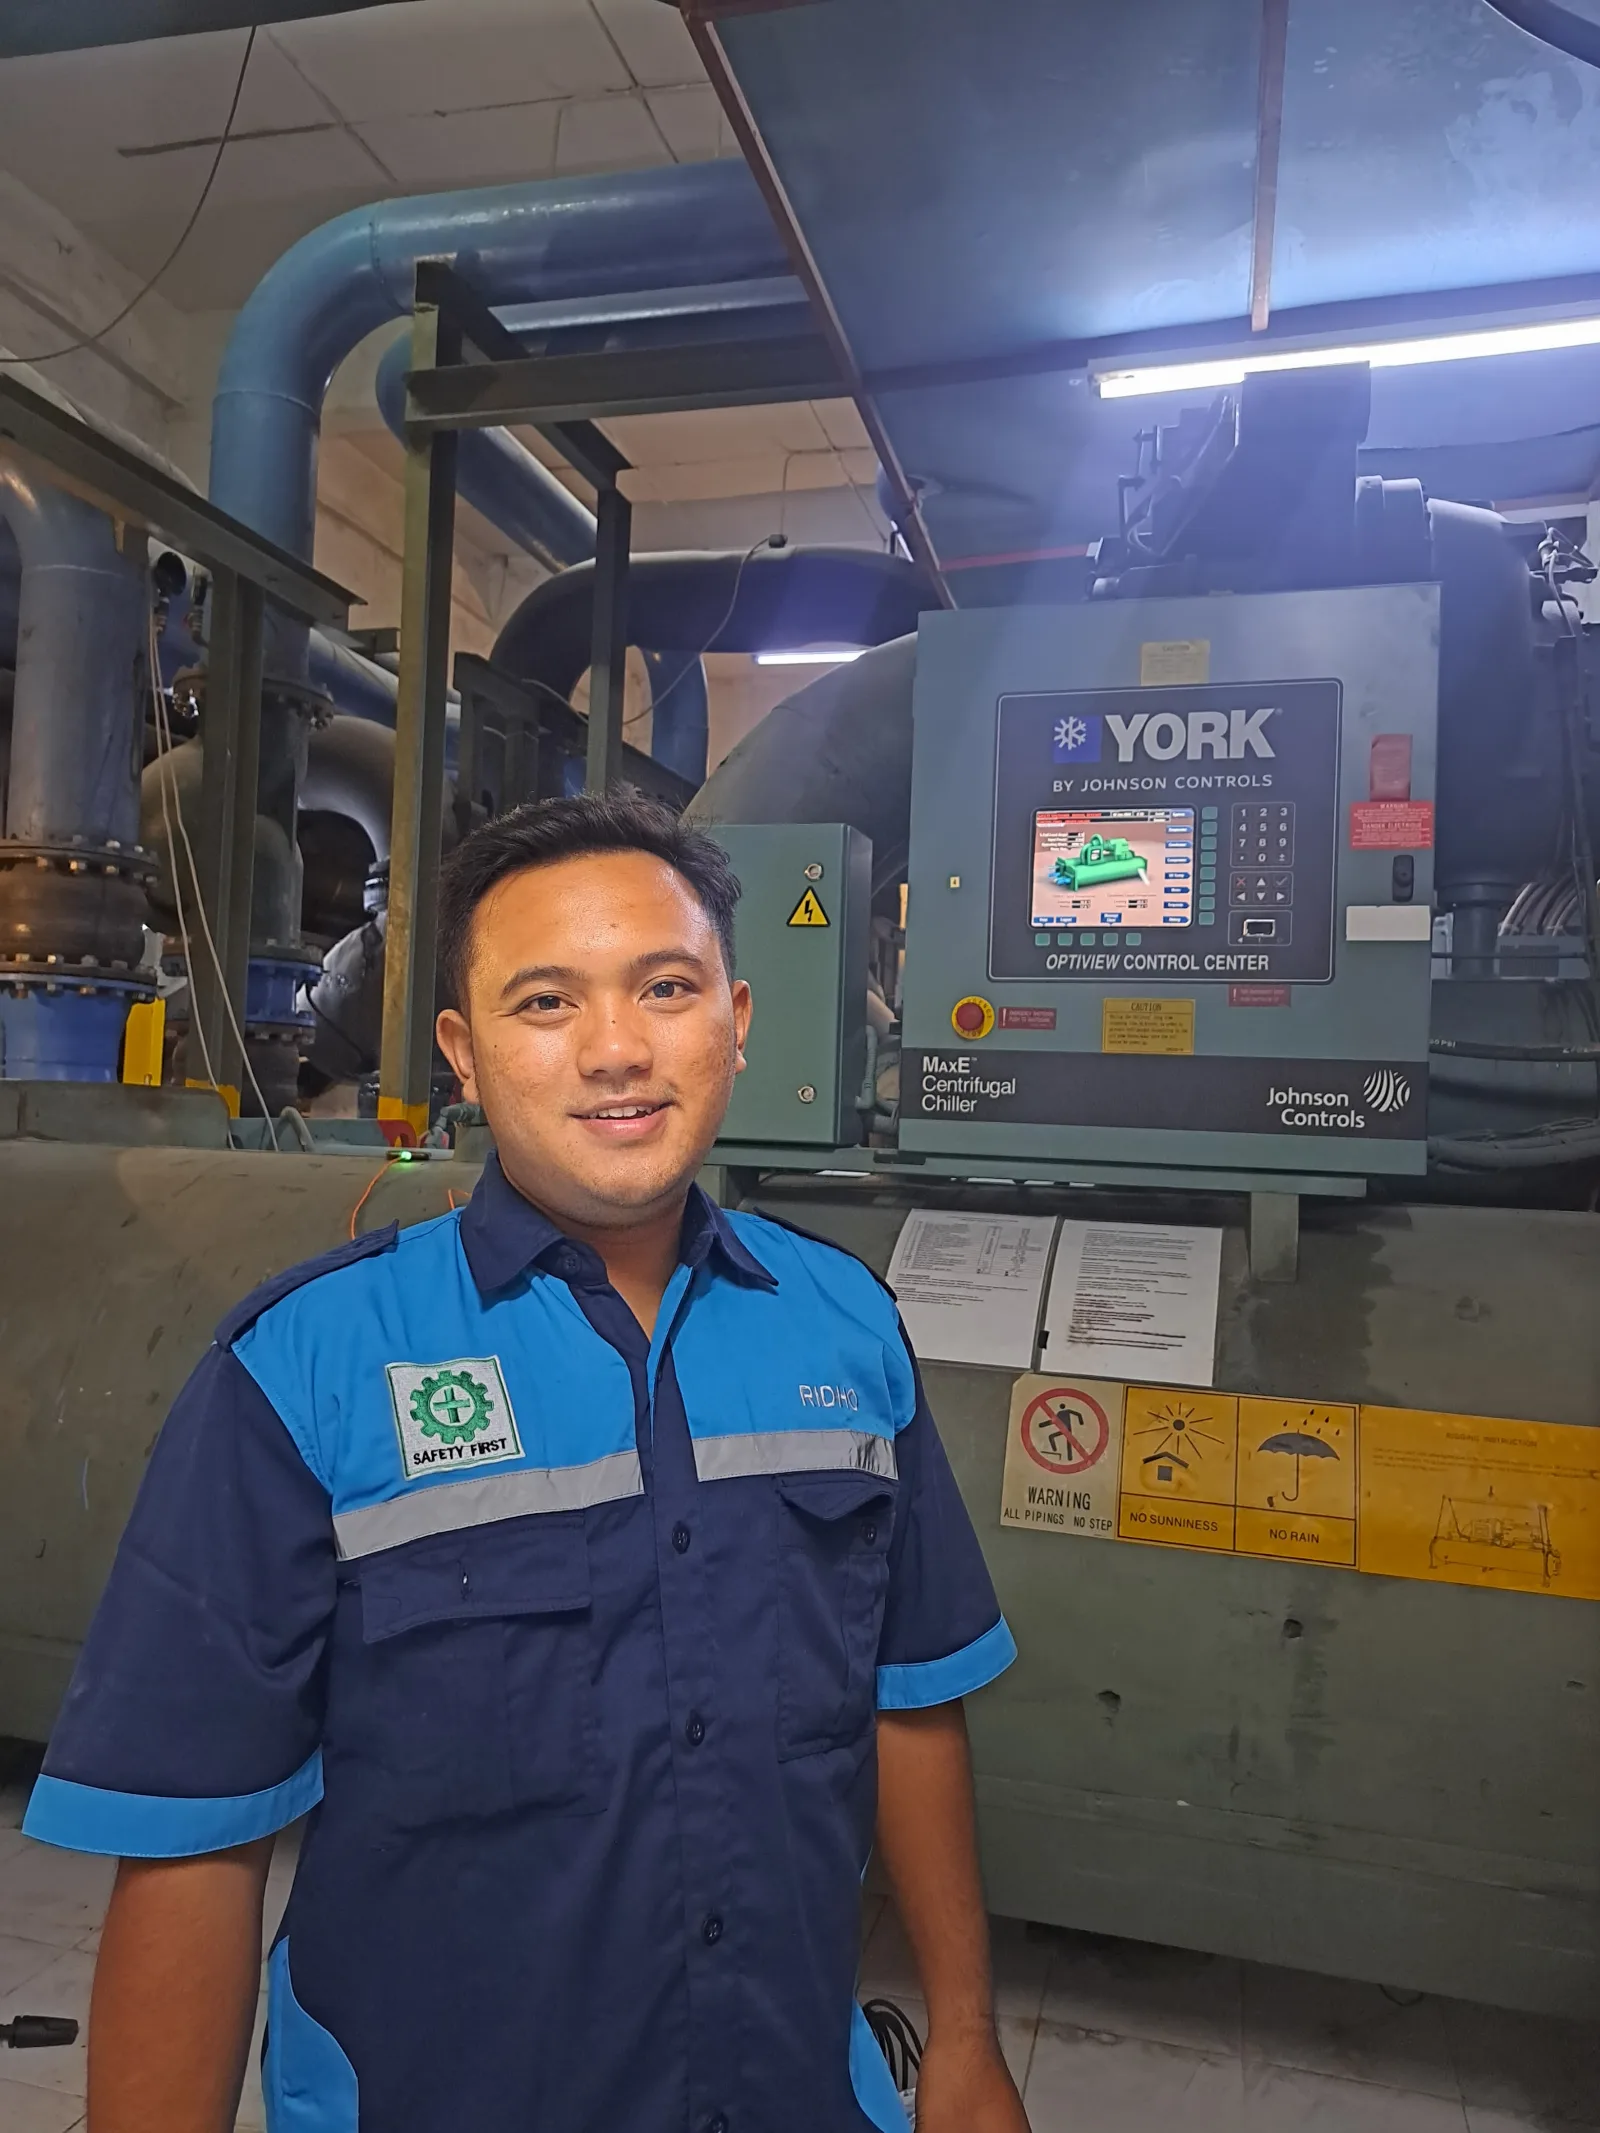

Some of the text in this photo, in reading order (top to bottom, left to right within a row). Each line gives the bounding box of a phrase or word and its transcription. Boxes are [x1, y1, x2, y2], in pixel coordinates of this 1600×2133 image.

[1053, 774, 1272, 792] BY JOHNSON CONTROLS
[1260, 808, 1267, 816] 2
[1280, 808, 1287, 816] 3
[1239, 823, 1287, 832] 4 5 6
[1239, 838, 1287, 847] 7 8 9
[1258, 853, 1266, 862] 0
[1046, 954, 1269, 971] OPTIVIEW CONTROL CENTER
[1131, 1002, 1162, 1012] CAUTION
[922, 1075, 1016, 1098] Centrifugal
[922, 1094, 977, 1112] Chiller
[1266, 1087, 1349, 1107] Johnson
[1281, 1108, 1365, 1128] Controls
[799, 1385, 858, 1411] RIDHO
[413, 1438, 507, 1465] SAFETY FIRST
[1028, 1486, 1091, 1510] WARNING
[1004, 1507, 1112, 1531] ALL PIPINGS NO STEP
[1130, 1512, 1218, 1532] NO SUNNINESS
[1269, 1528, 1320, 1544] NO RAIN
